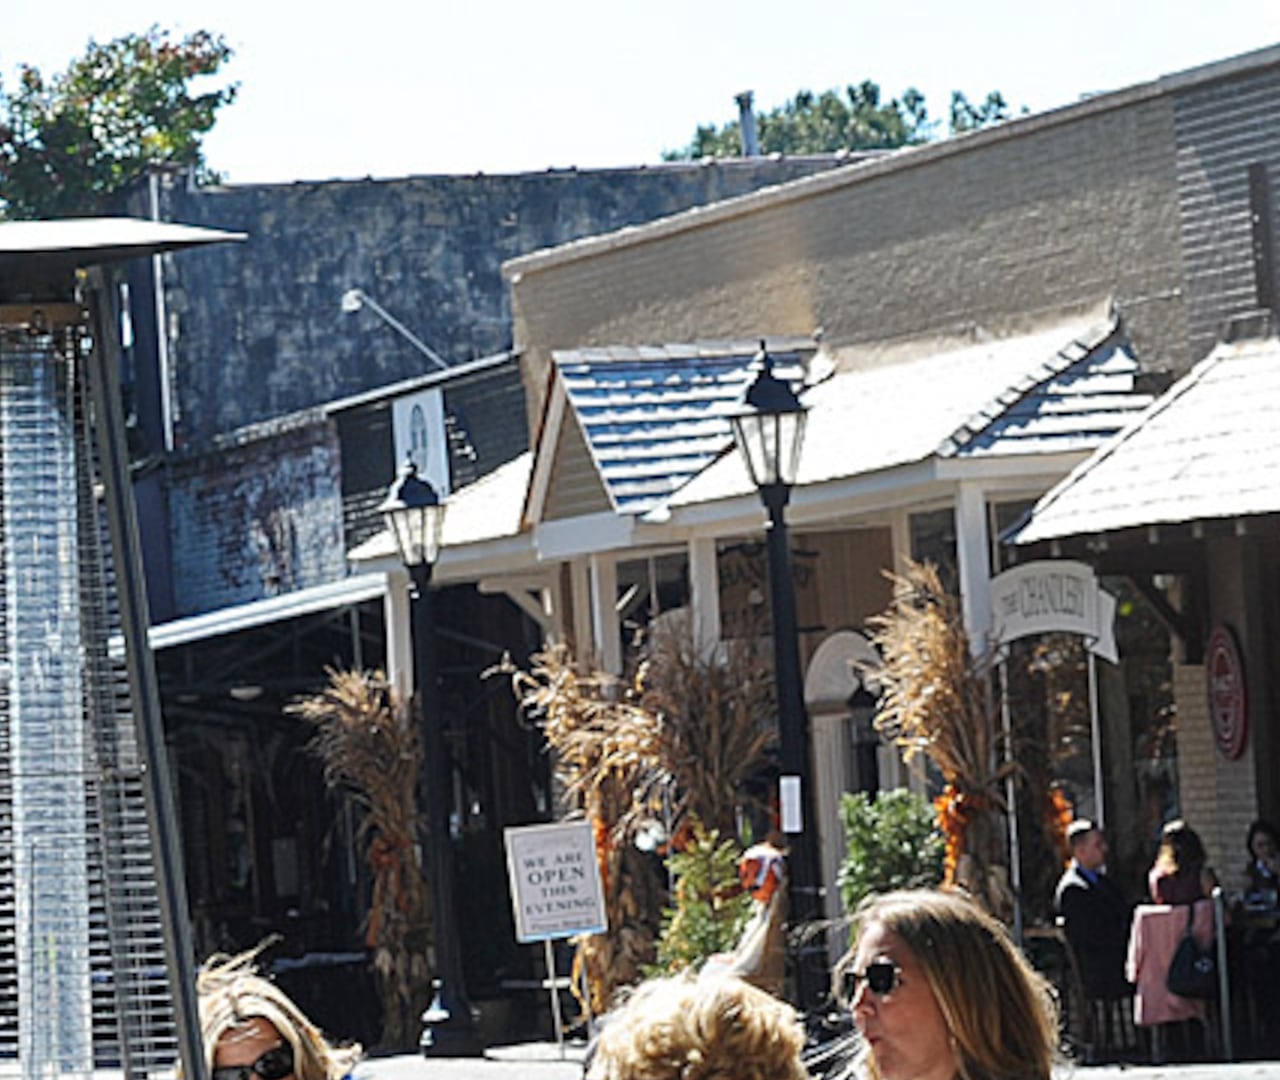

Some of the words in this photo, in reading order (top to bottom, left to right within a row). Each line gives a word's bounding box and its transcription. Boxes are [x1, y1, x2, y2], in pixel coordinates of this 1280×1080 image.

[523, 857, 546, 868] WE
[554, 852, 582, 865] ARE
[528, 866, 585, 885] OPEN
[541, 884, 577, 898] THIS
[525, 897, 596, 915] EVENING
